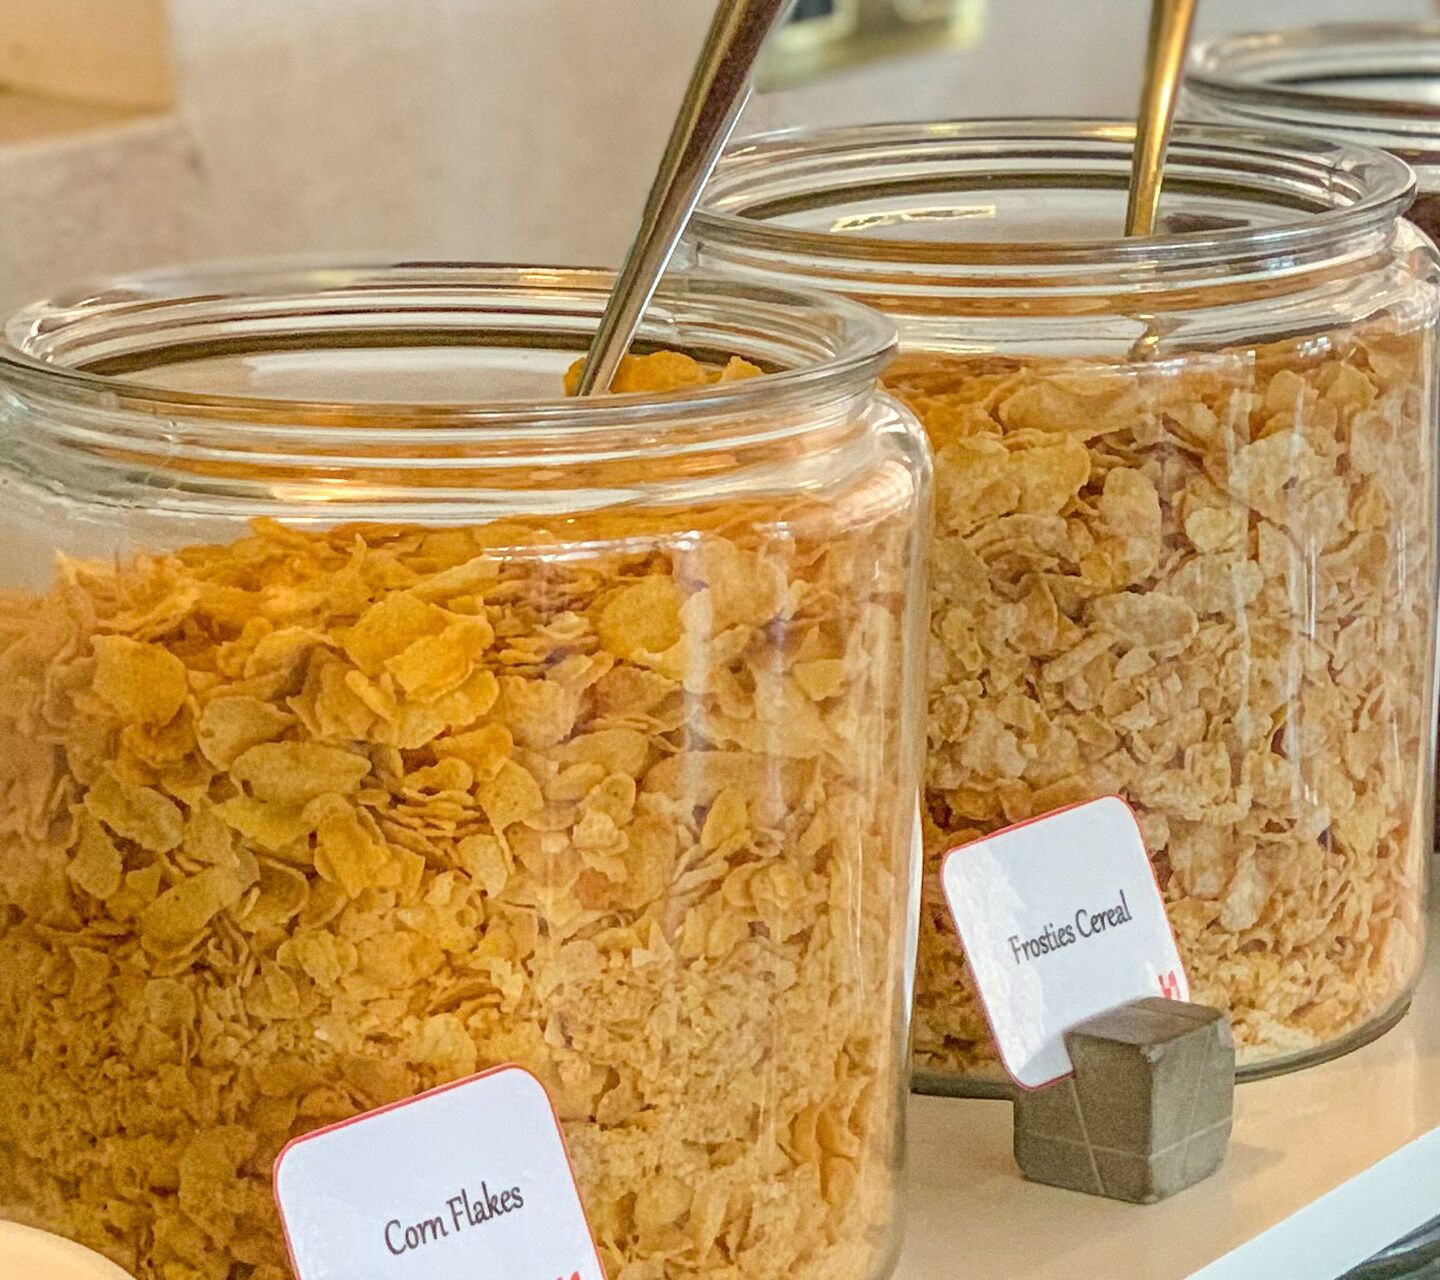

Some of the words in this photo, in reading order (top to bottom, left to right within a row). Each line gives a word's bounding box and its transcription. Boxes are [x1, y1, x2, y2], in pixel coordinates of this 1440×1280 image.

[1008, 922, 1077, 965] Frosties
[1075, 889, 1132, 938] Cereal
[384, 1216, 449, 1255] Corn
[446, 1181, 524, 1232] Flakes
